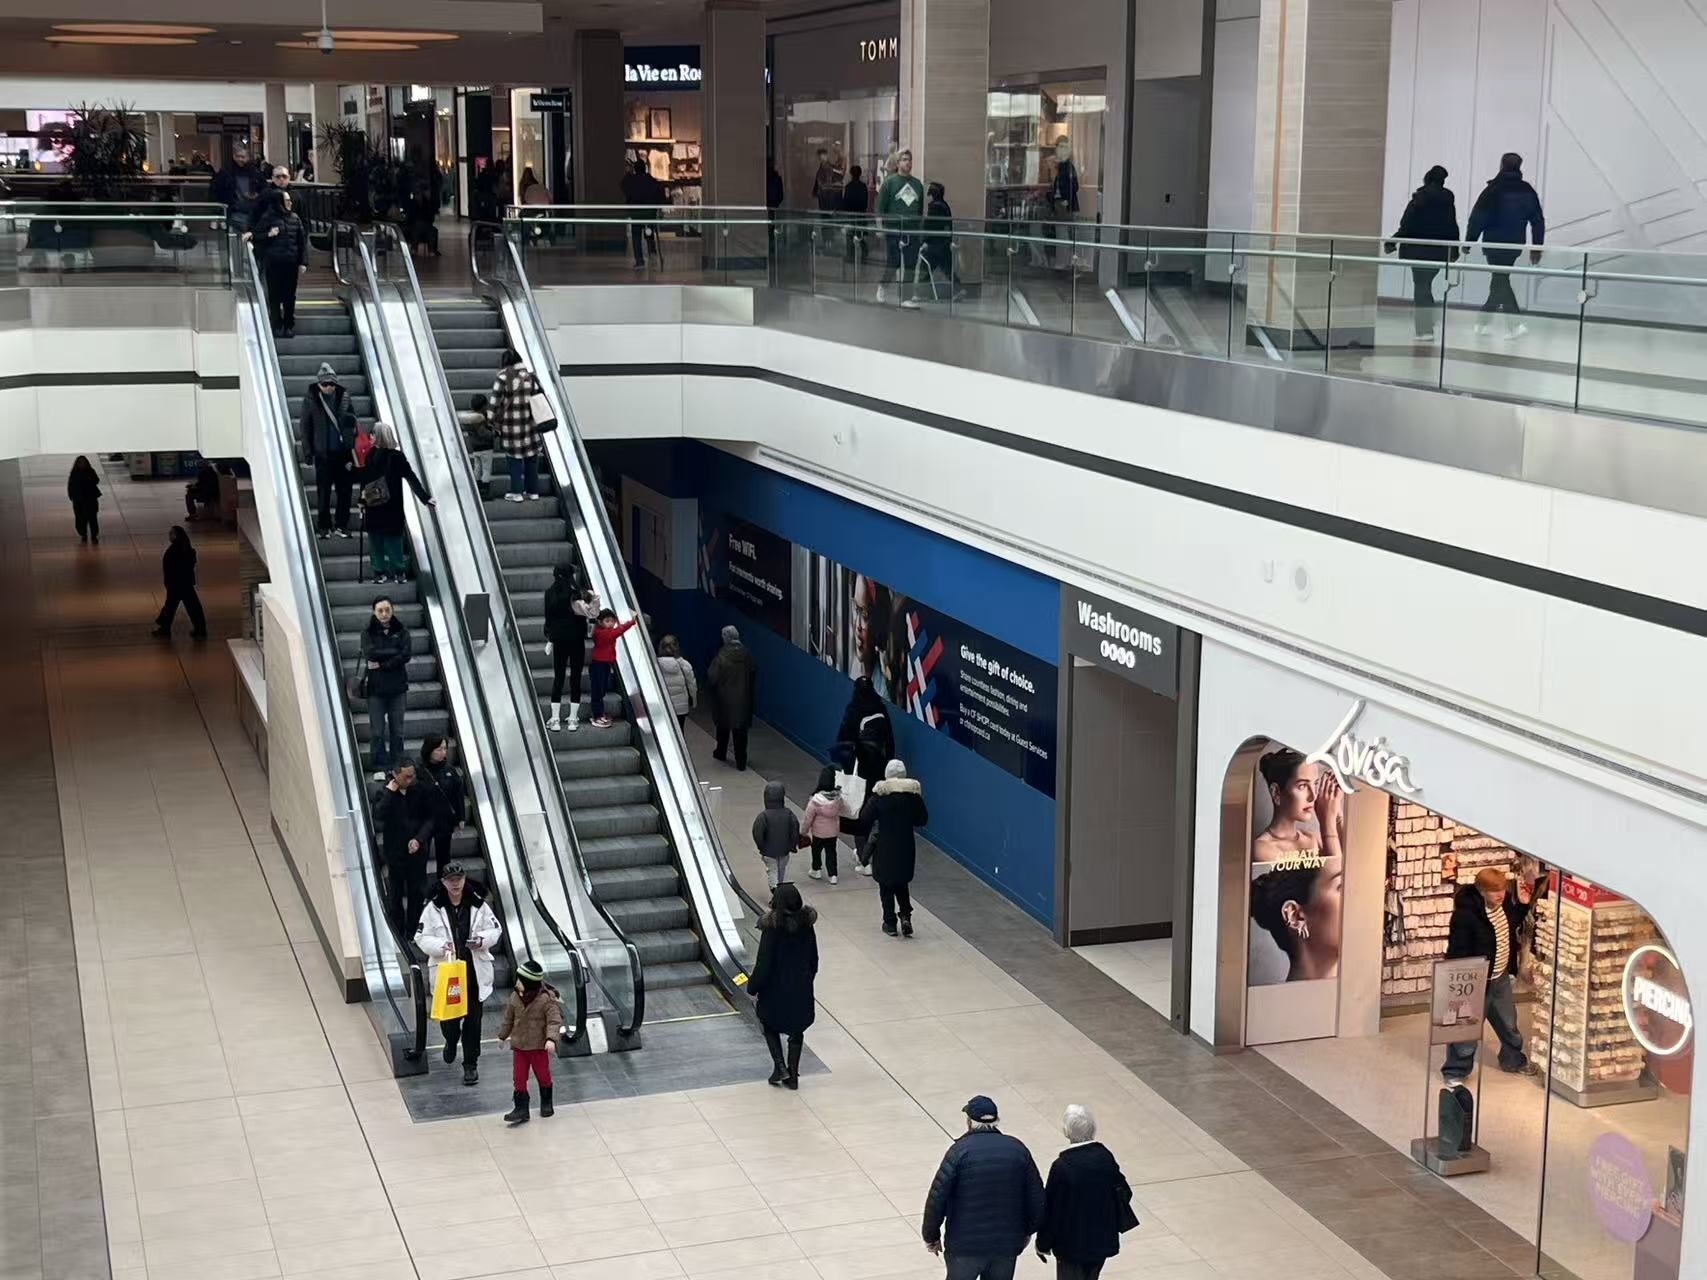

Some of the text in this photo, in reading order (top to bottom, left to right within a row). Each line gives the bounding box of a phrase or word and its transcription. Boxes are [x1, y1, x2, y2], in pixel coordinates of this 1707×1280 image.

[860, 37, 898, 61] TOMM
[625, 64, 637, 82] la
[637, 64, 659, 82] Vie
[660, 68, 677, 82] en
[1077, 600, 1162, 656] Washrooms
[960, 645, 1036, 694] Give the gift of choice.
[1028, 741, 1049, 760] Services
[1305, 699, 1417, 795] Lovisa
[1270, 858, 1328, 872] YOUR WAY
[1449, 971, 1478, 982] 3 FOR
[1448, 983, 1474, 997] $30
